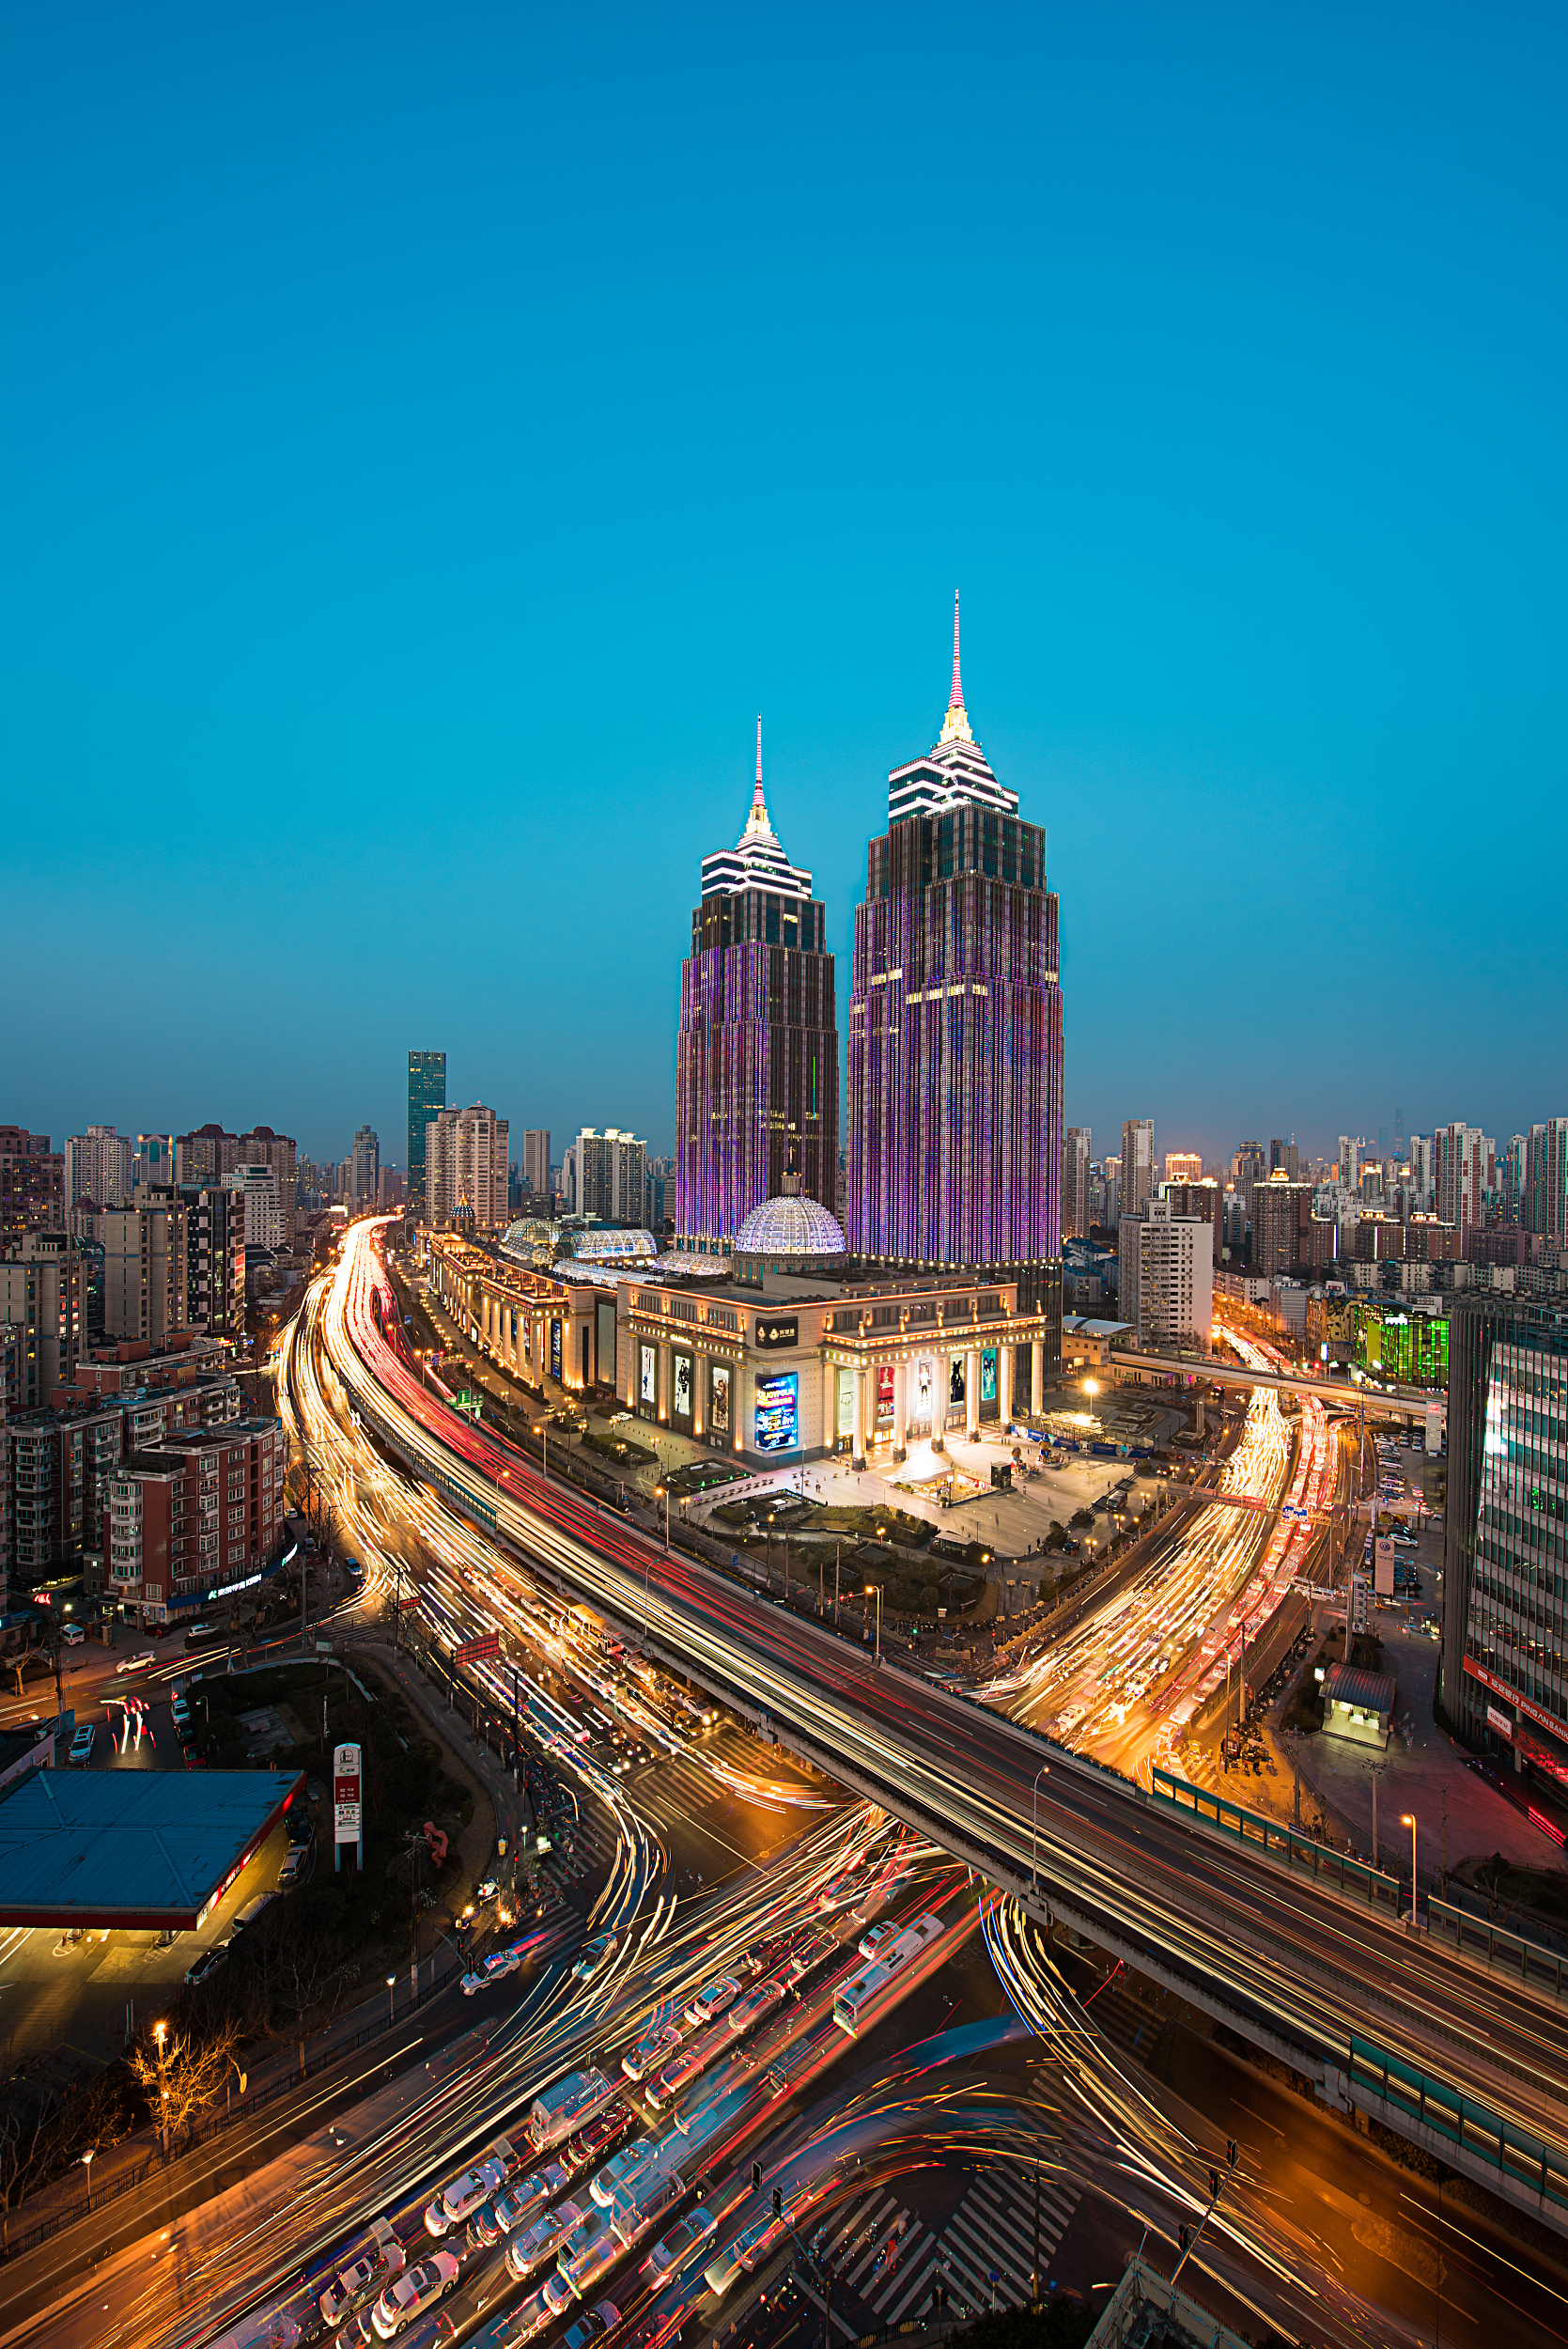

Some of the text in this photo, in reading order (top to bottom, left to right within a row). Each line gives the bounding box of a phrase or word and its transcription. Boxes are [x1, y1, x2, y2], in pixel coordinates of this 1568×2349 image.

[1491, 1677, 1568, 1739] 平安银行 PING AN BANK
